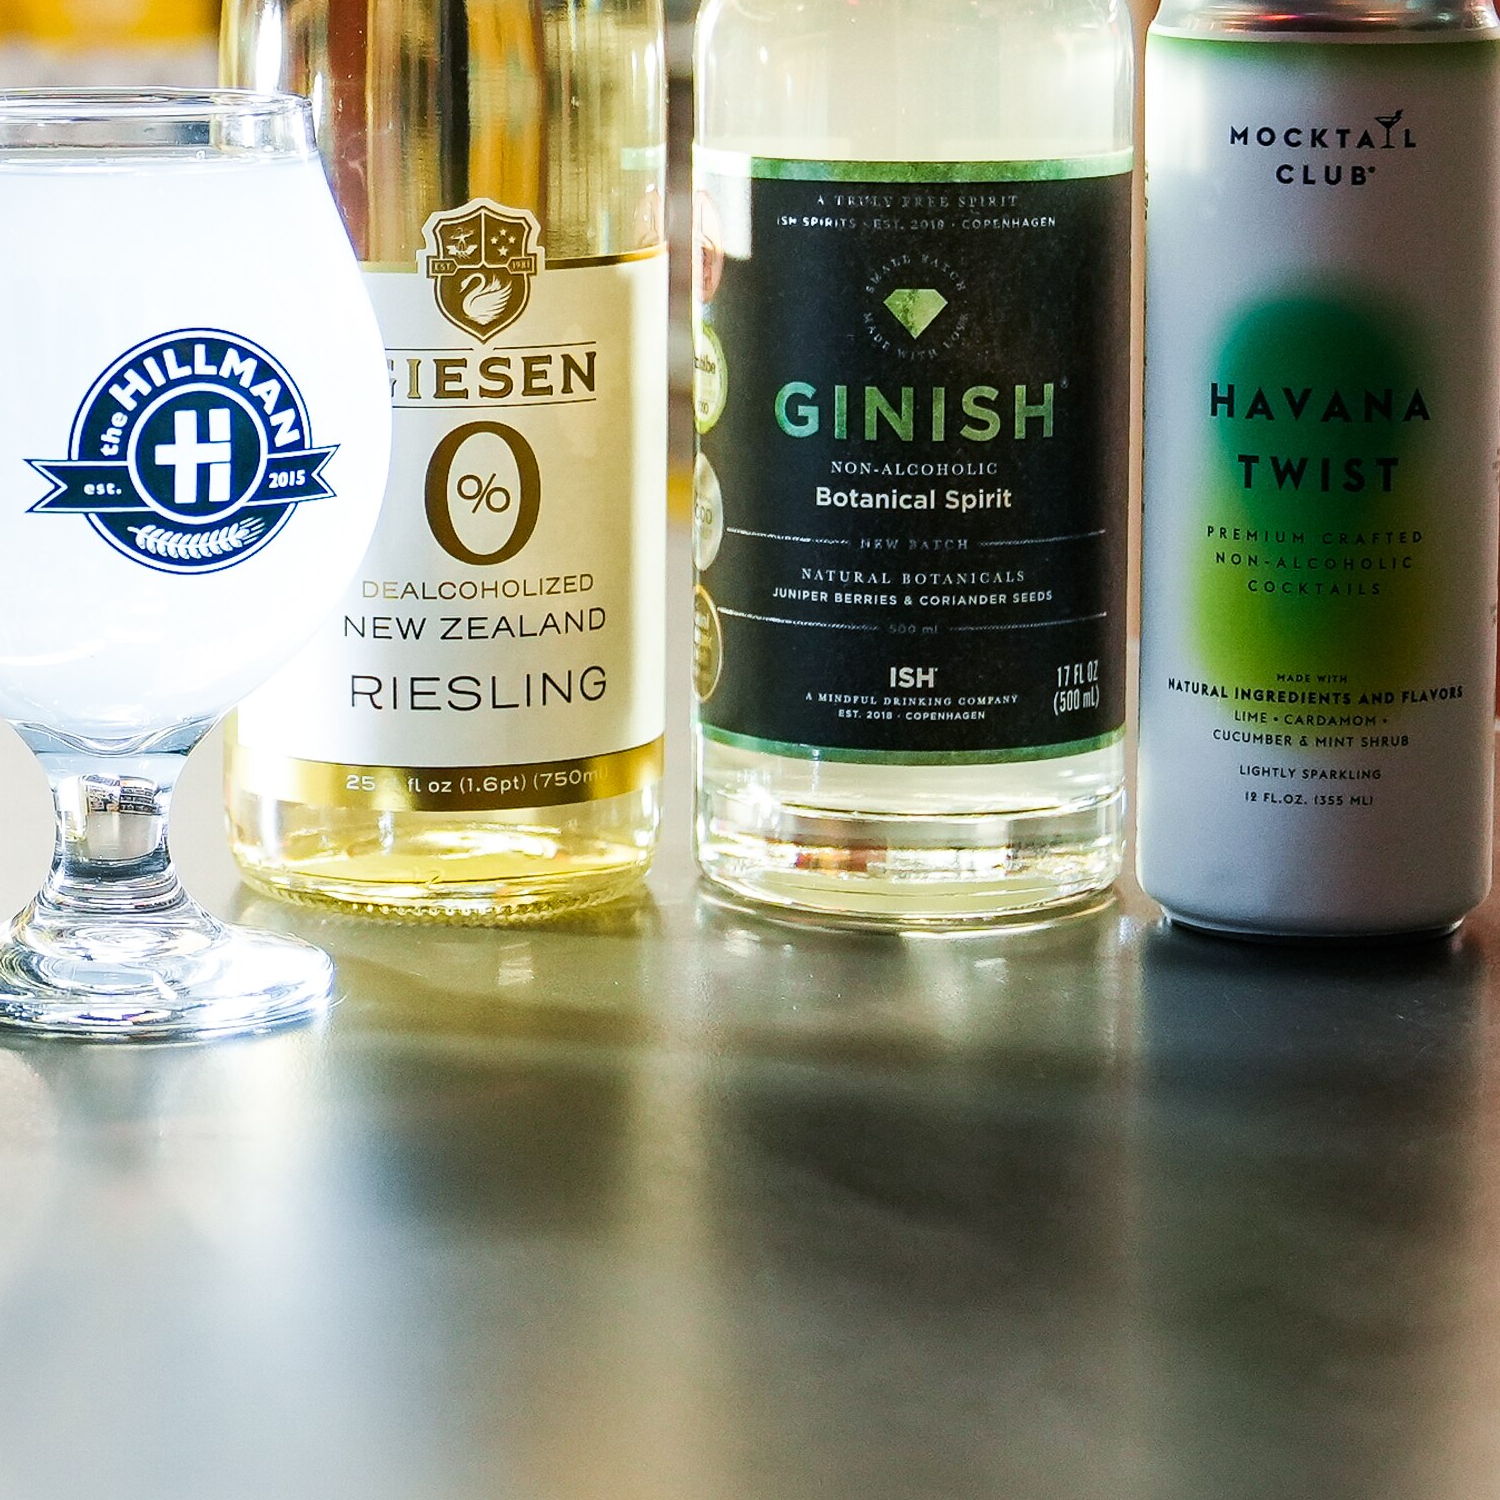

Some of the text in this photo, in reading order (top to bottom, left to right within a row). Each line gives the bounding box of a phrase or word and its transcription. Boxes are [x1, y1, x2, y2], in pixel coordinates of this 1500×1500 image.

[901, 195, 950, 209] FREE
[957, 194, 1019, 209] SPIRIT
[802, 216, 857, 229] SPIRITS
[961, 216, 1057, 230] COPENHAGEN
[99, 343, 301, 458] the HILLMAN
[1209, 382, 1431, 424] HAVANA
[830, 460, 999, 477] NON-ALCOHOLIC
[1237, 453, 1400, 493] TWIST
[83, 469, 306, 496] est. 2015
[815, 486, 1012, 514] Botanical Spirit
[1206, 525, 1424, 546] PREMIUM CRAFTED
[1215, 551, 1414, 571] NON-ALCOHOLIC
[361, 572, 595, 601] DEALCOHOLIZED
[801, 567, 1026, 586] NATURAL BOTANICALS
[772, 587, 1054, 607] JUNIPER BERRIES & CORIANDER SEEDS
[1247, 579, 1382, 597] COCKTAILS
[343, 606, 607, 641] NEW ZEALAND
[1055, 658, 1100, 688] 17 FL OZ
[1276, 673, 1348, 685] MADE WITH
[350, 665, 607, 712] RIESLING
[1167, 677, 1464, 706] NATURAL INGREDIENTS AND FLAVORS
[818, 693, 878, 706] MINDFUL
[883, 695, 953, 707] DRINKING
[958, 693, 1019, 706] COMPANY
[1052, 688, 1080, 717] (500
[837, 709, 987, 722] EST. 2018 COPENHAGEN
[1234, 710, 1378, 727] LIME CARDAMOM
[1212, 728, 1293, 748] CUCUMBER
[1315, 735, 1355, 748] MINT
[1360, 734, 1410, 748] SHRUB
[1239, 764, 1383, 781] LIGHTLY SPARKLING
[407, 777, 422, 794] fl
[428, 779, 453, 794] oz
[459, 774, 528, 796] (1.6pt)
[1245, 790, 1258, 803] 12
